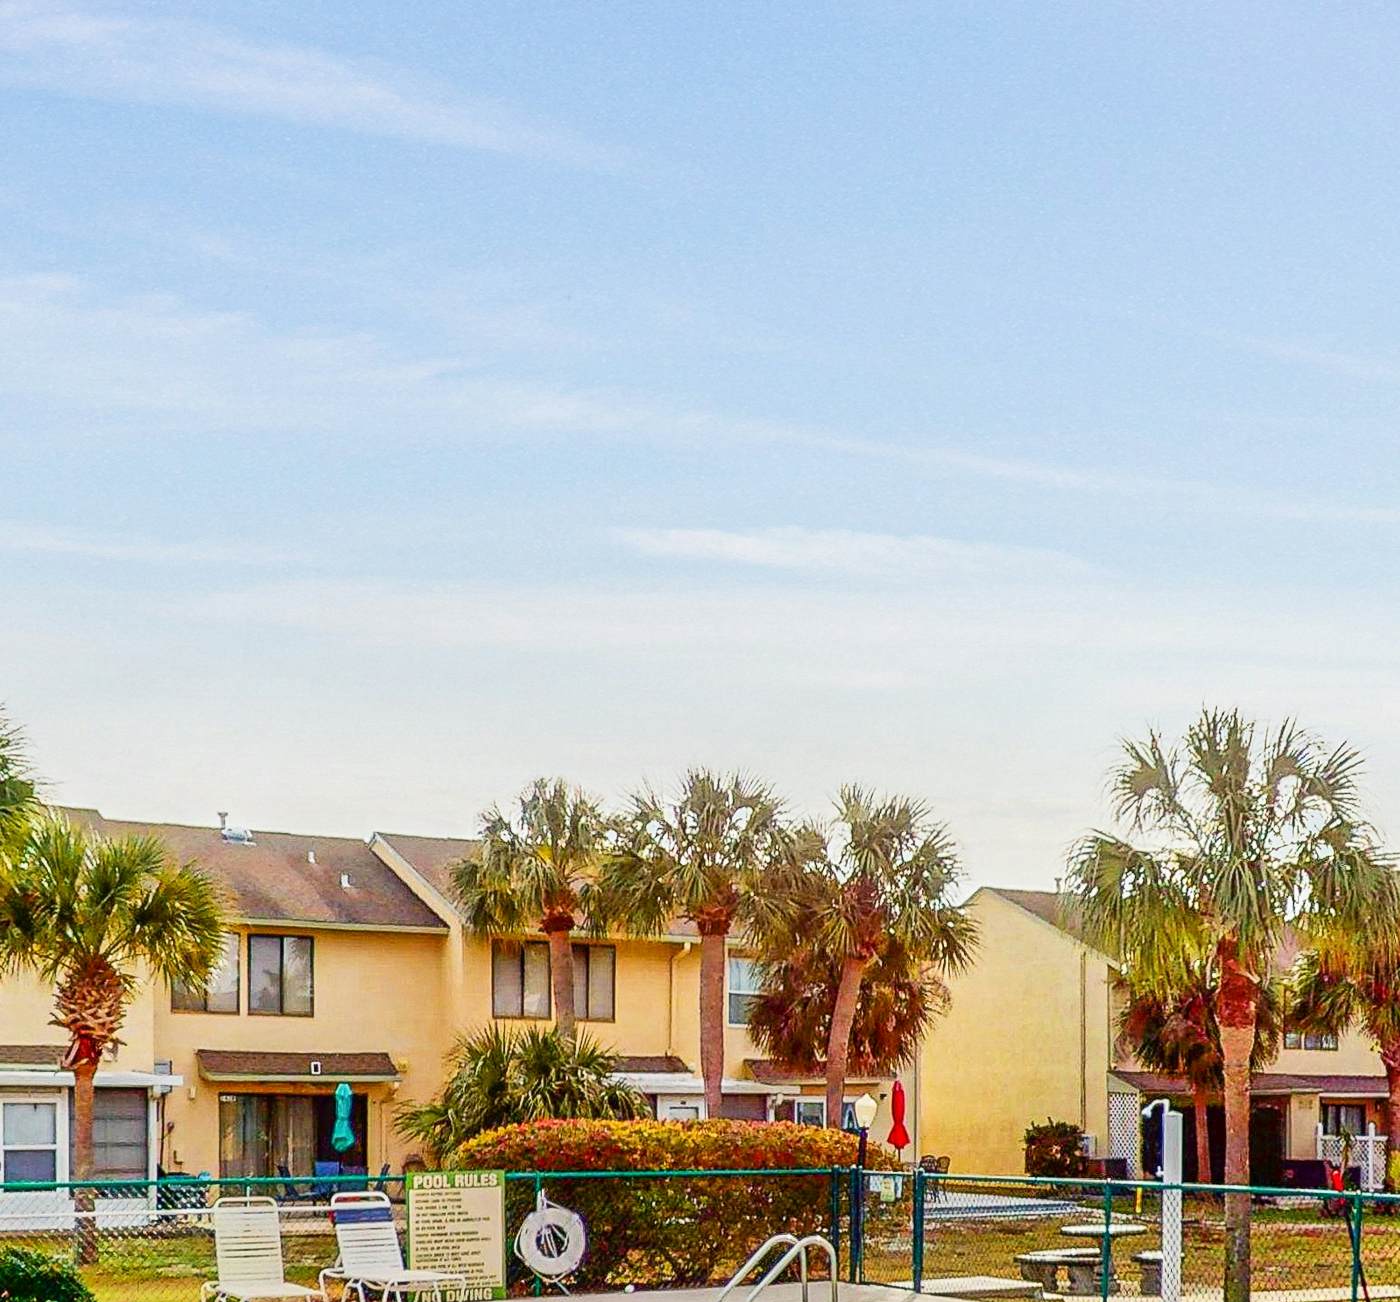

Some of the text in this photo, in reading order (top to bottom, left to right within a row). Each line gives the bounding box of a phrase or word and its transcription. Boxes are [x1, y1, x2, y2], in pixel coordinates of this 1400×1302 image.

[413, 1172, 498, 1189] POOL RULES
[446, 1287, 493, 1302] DIVING
